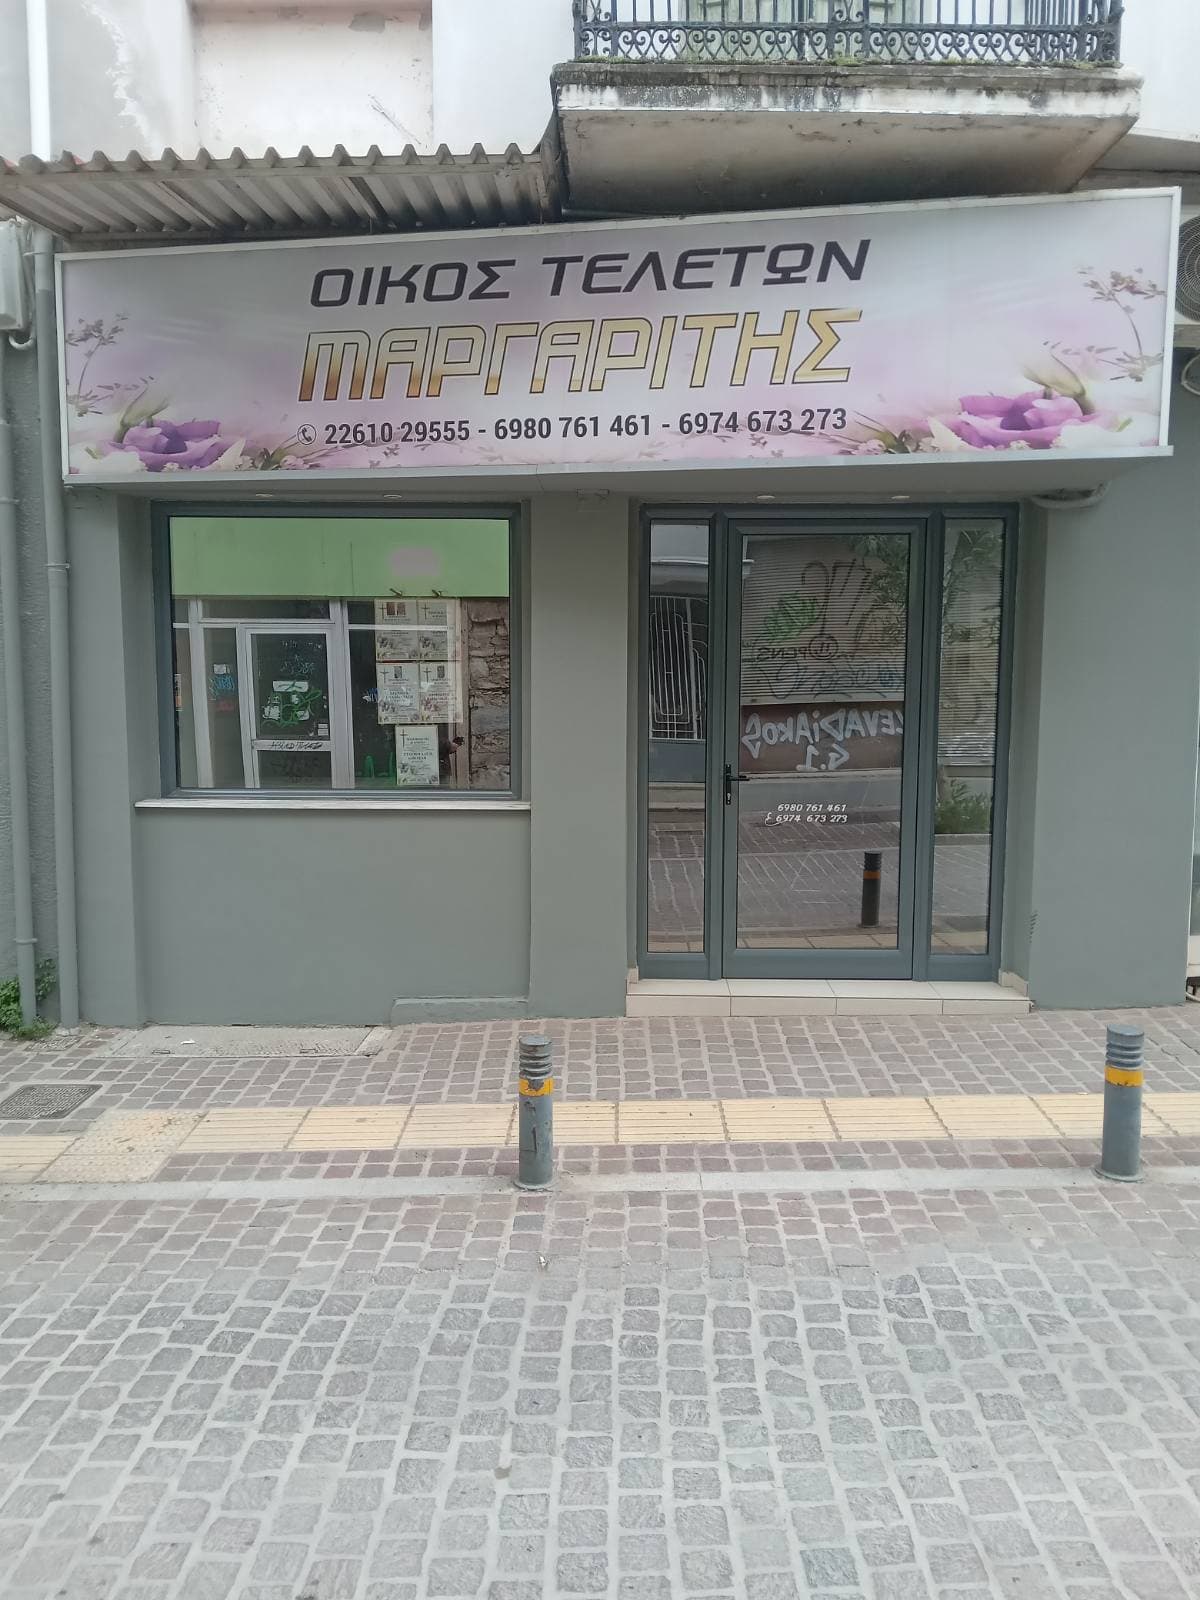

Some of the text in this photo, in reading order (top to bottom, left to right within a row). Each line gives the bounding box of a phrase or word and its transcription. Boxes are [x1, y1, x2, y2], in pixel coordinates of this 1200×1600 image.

[311, 238, 870, 308] ΟΙΚΟΣ ΤΕΛΕΤΩΝ
[298, 308, 862, 402] ΜΑΡΓΑΡΙΤΗΣ
[325, 422, 393, 446] 22610
[400, 420, 470, 443] 29555
[494, 417, 551, 440] 6980
[558, 416, 599, 438] 761
[609, 414, 650, 436] 461
[679, 411, 739, 435] 6974
[747, 409, 792, 433] 673
[801, 408, 846, 431] 273
[776, 814, 848, 823] 6974 673 273
[777, 803, 847, 812] 6980 761 461
